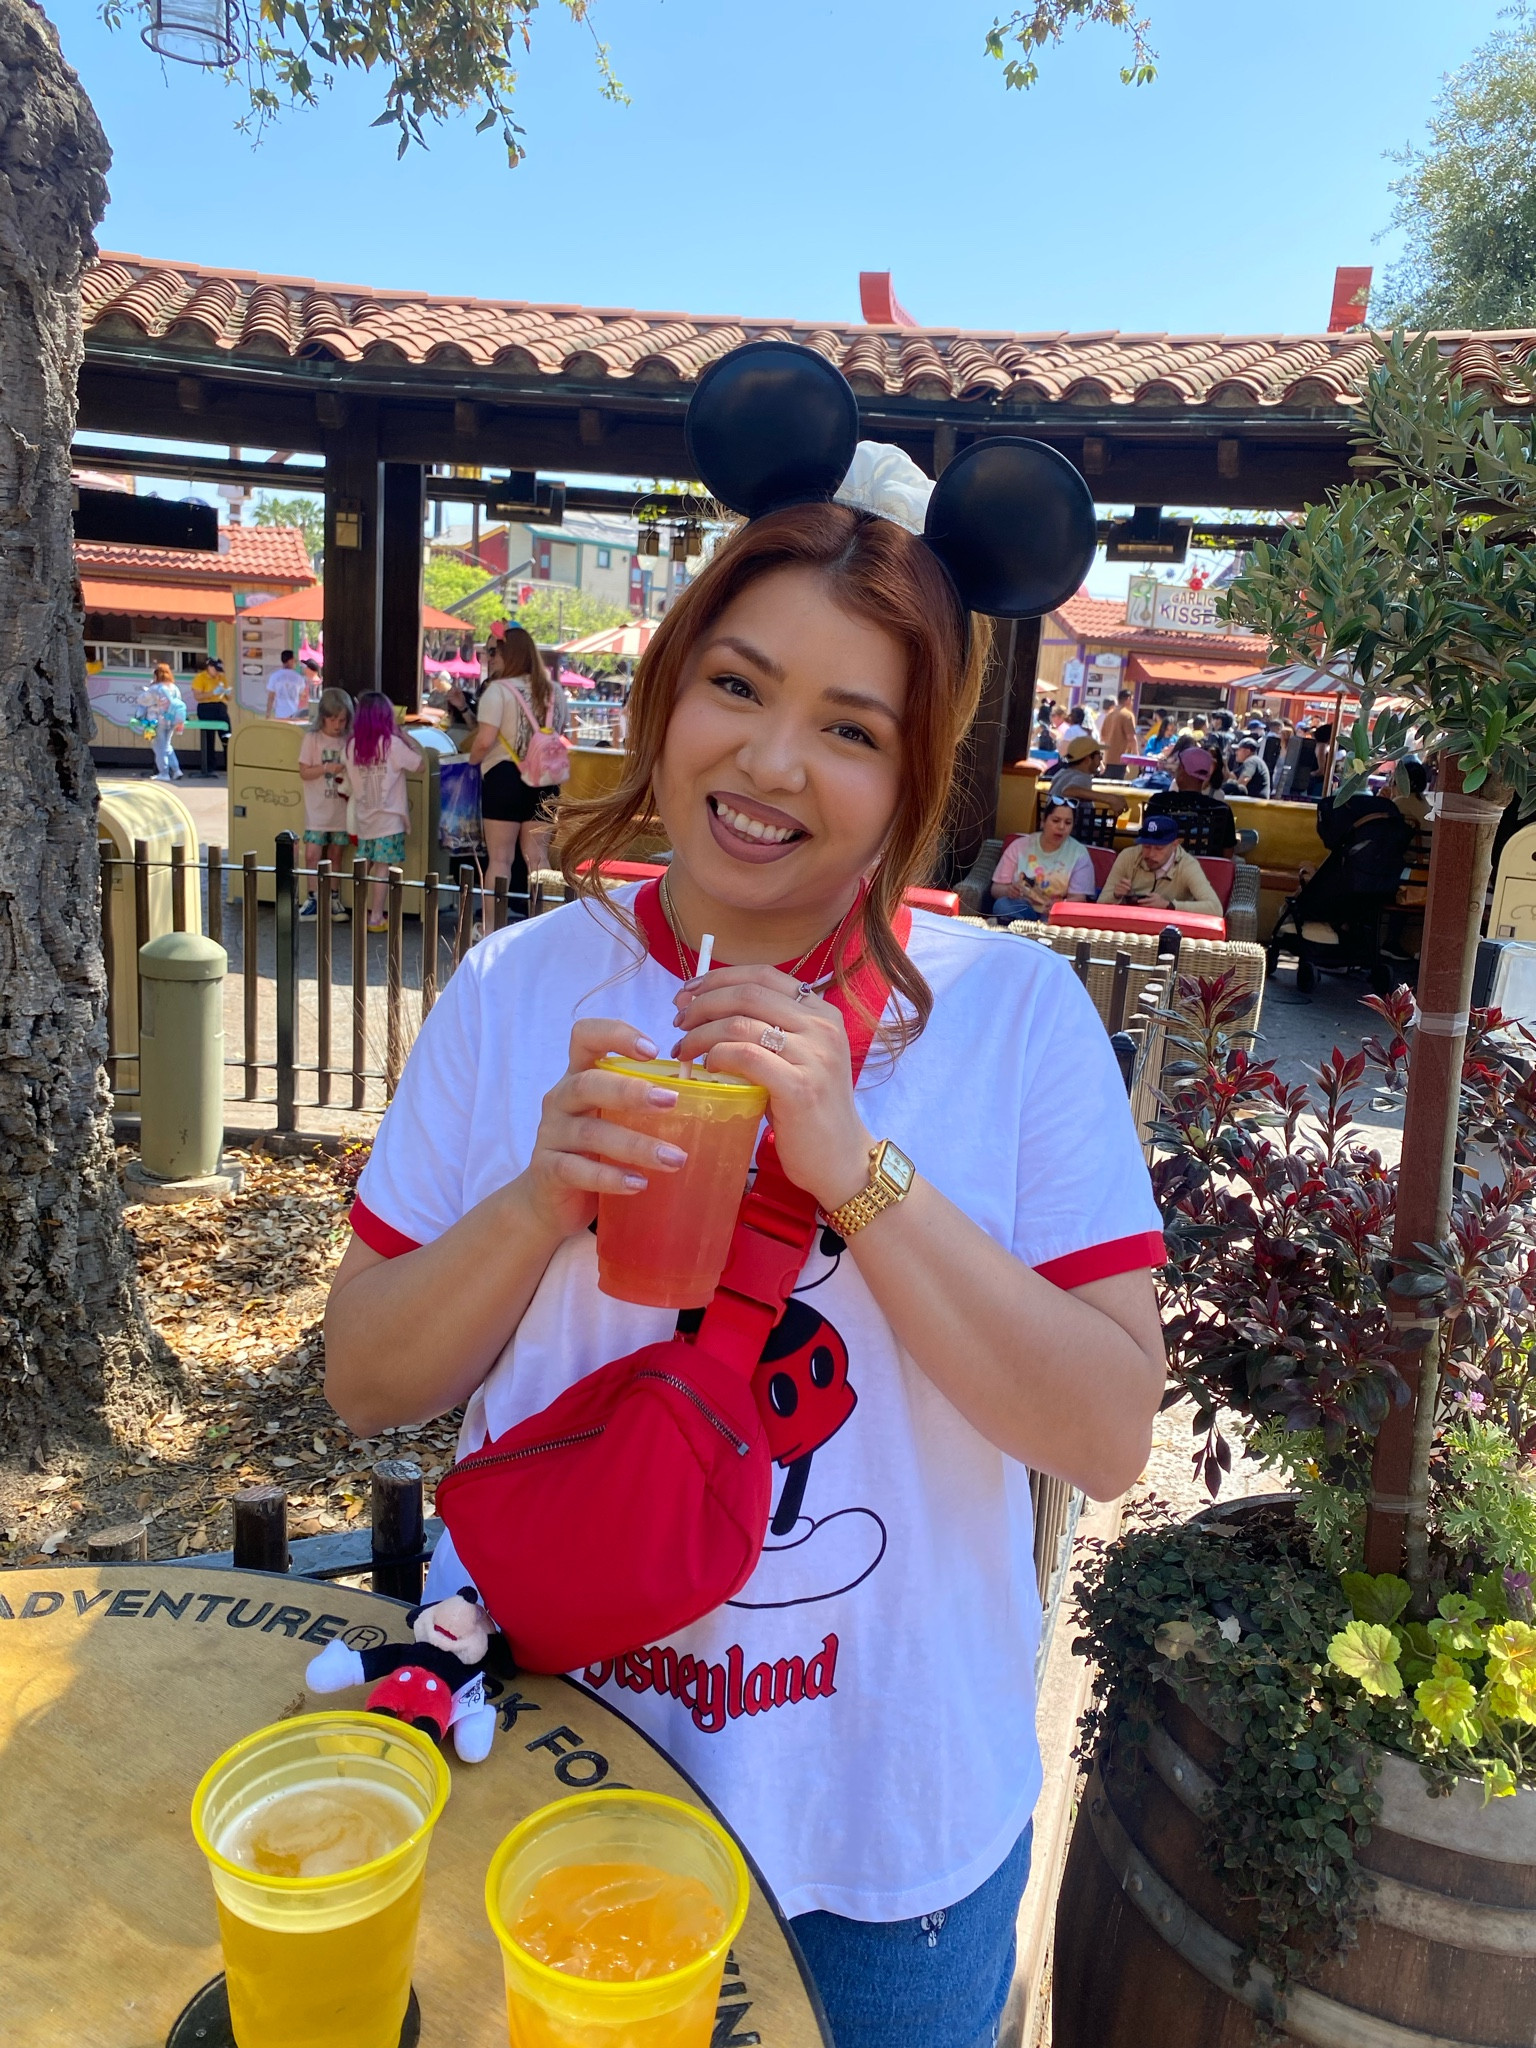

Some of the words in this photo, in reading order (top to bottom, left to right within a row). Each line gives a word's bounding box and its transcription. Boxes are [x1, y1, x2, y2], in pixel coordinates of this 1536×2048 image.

[1171, 592, 1215, 607] GARLIC
[1160, 604, 1221, 626] KISSE
[525, 1725, 633, 1789] FO
